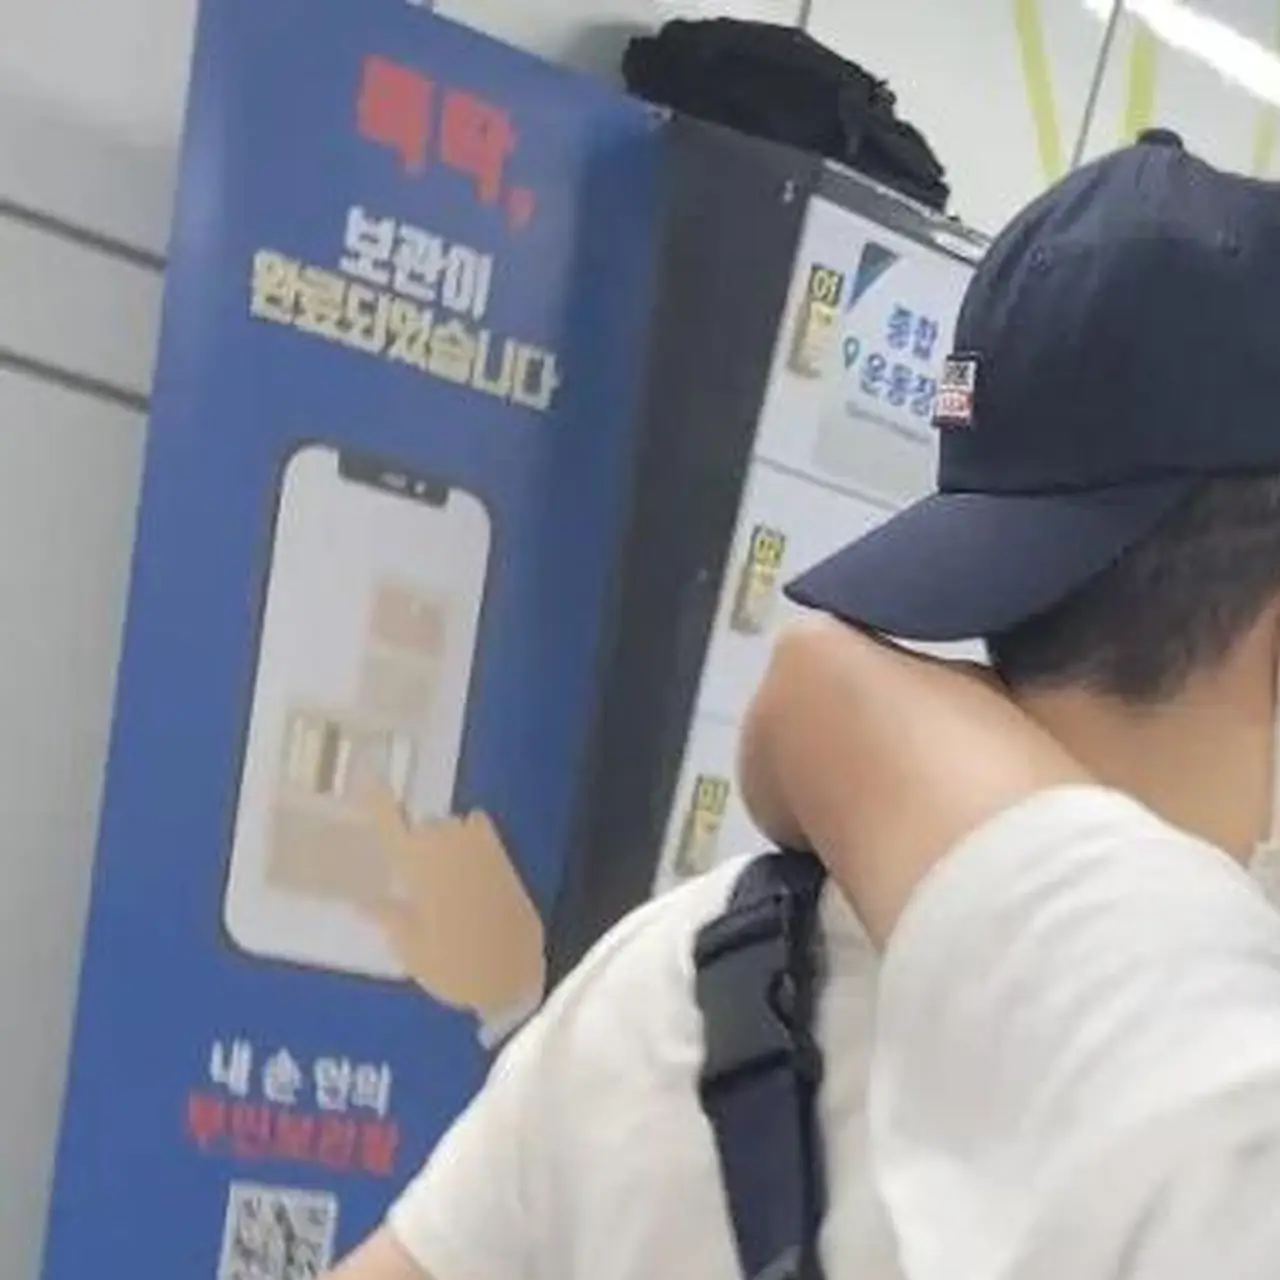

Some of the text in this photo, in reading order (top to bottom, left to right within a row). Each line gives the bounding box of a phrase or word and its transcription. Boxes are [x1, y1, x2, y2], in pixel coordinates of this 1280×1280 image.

[340, 206, 494, 321] 보관이
[251, 249, 560, 411] 완료되었습니다
[209, 1037, 391, 1117] 내 손 안의
